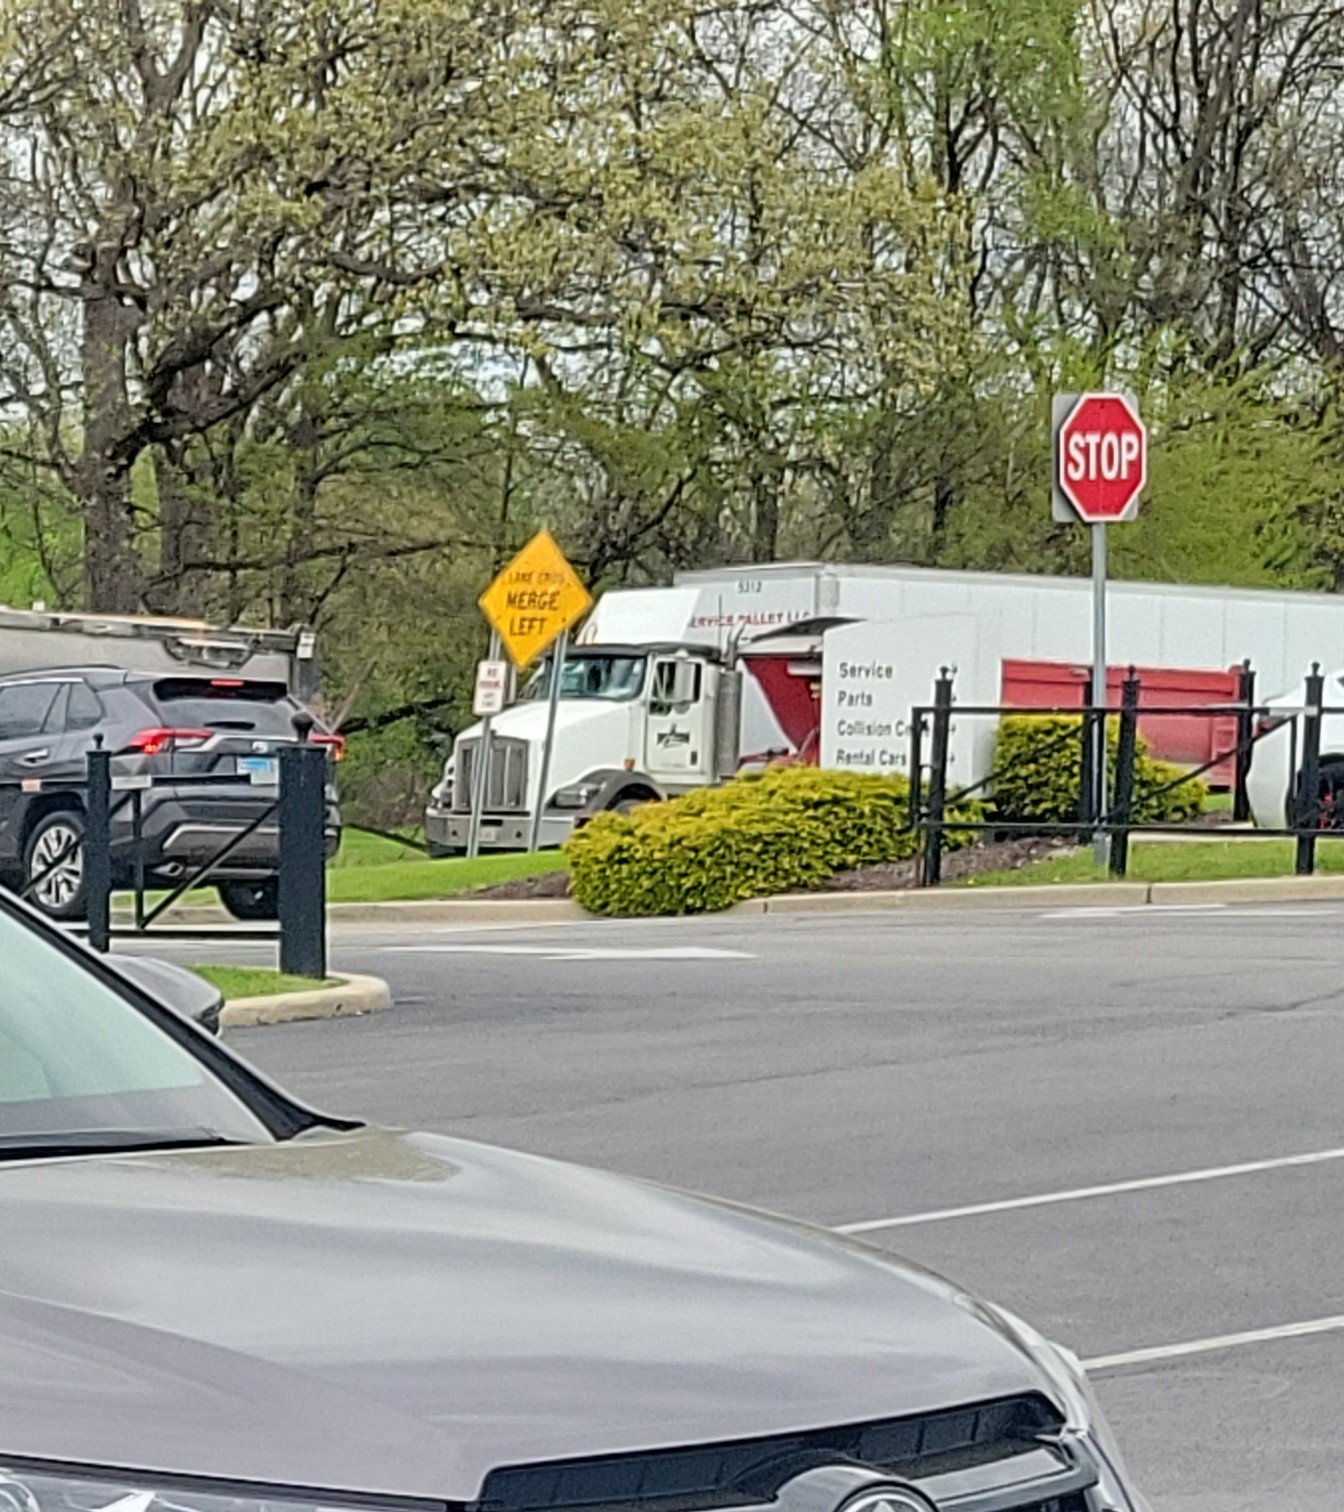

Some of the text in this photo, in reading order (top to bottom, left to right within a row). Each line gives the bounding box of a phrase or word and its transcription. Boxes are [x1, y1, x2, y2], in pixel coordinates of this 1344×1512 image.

[1067, 431, 1140, 481] STOP
[506, 589, 561, 611] MERGE
[510, 616, 547, 636] LEFT
[838, 660, 894, 679] Service
[837, 690, 873, 706] Parts
[837, 719, 892, 737] Collision
[836, 748, 907, 766] Rental Cars
